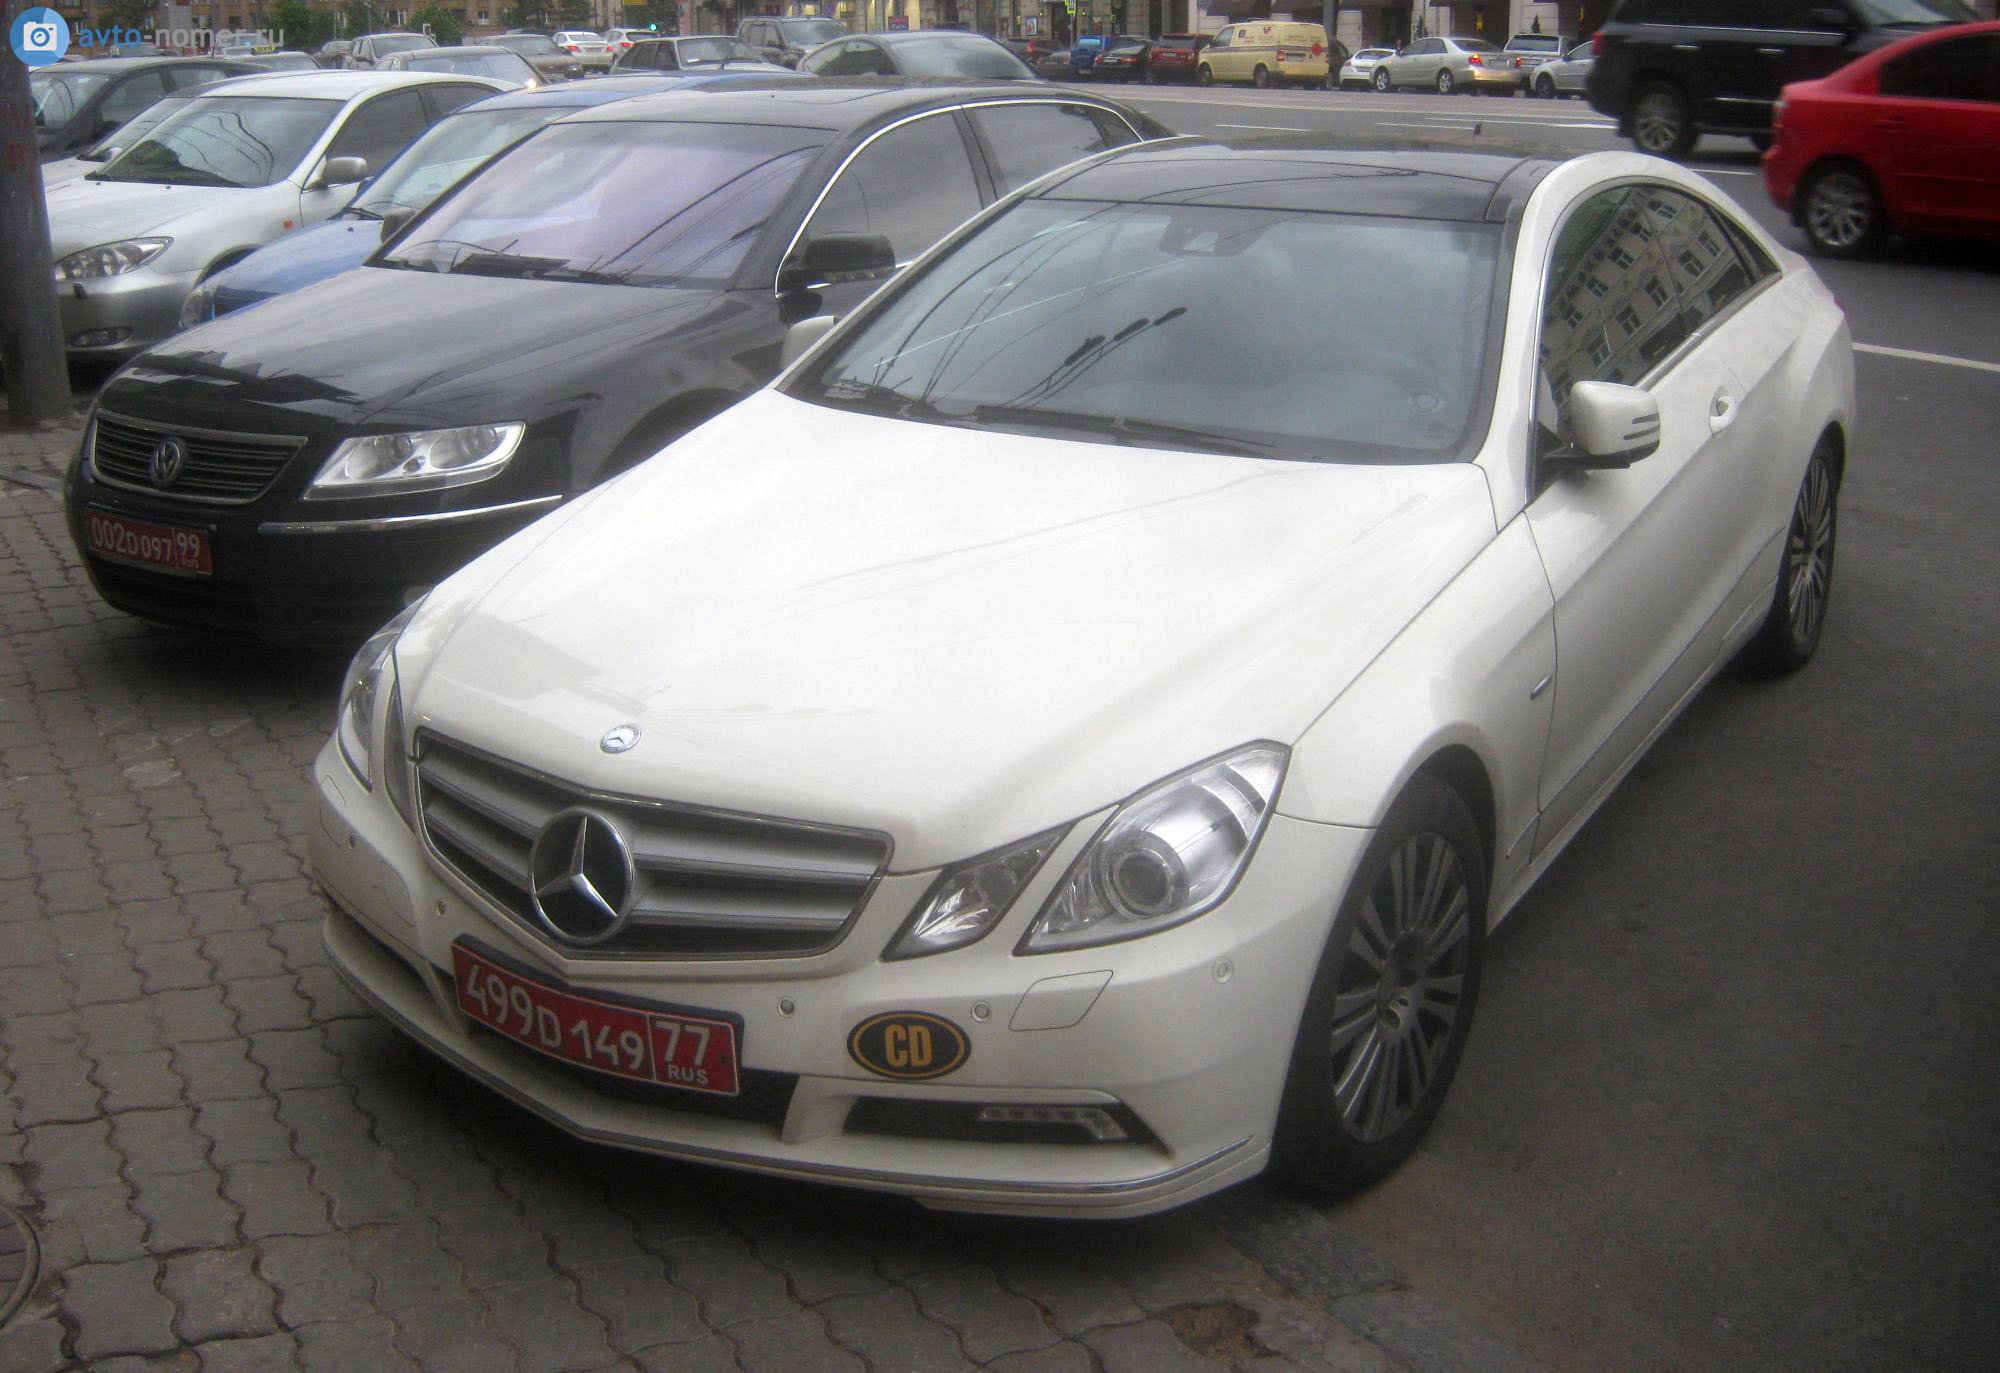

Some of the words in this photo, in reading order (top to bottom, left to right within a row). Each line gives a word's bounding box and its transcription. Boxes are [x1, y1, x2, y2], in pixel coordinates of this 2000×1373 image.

[177, 532, 200, 557] 99
[656, 1021, 710, 1065] 77
[885, 1024, 932, 1067] CD
[667, 1064, 708, 1085] RUS
